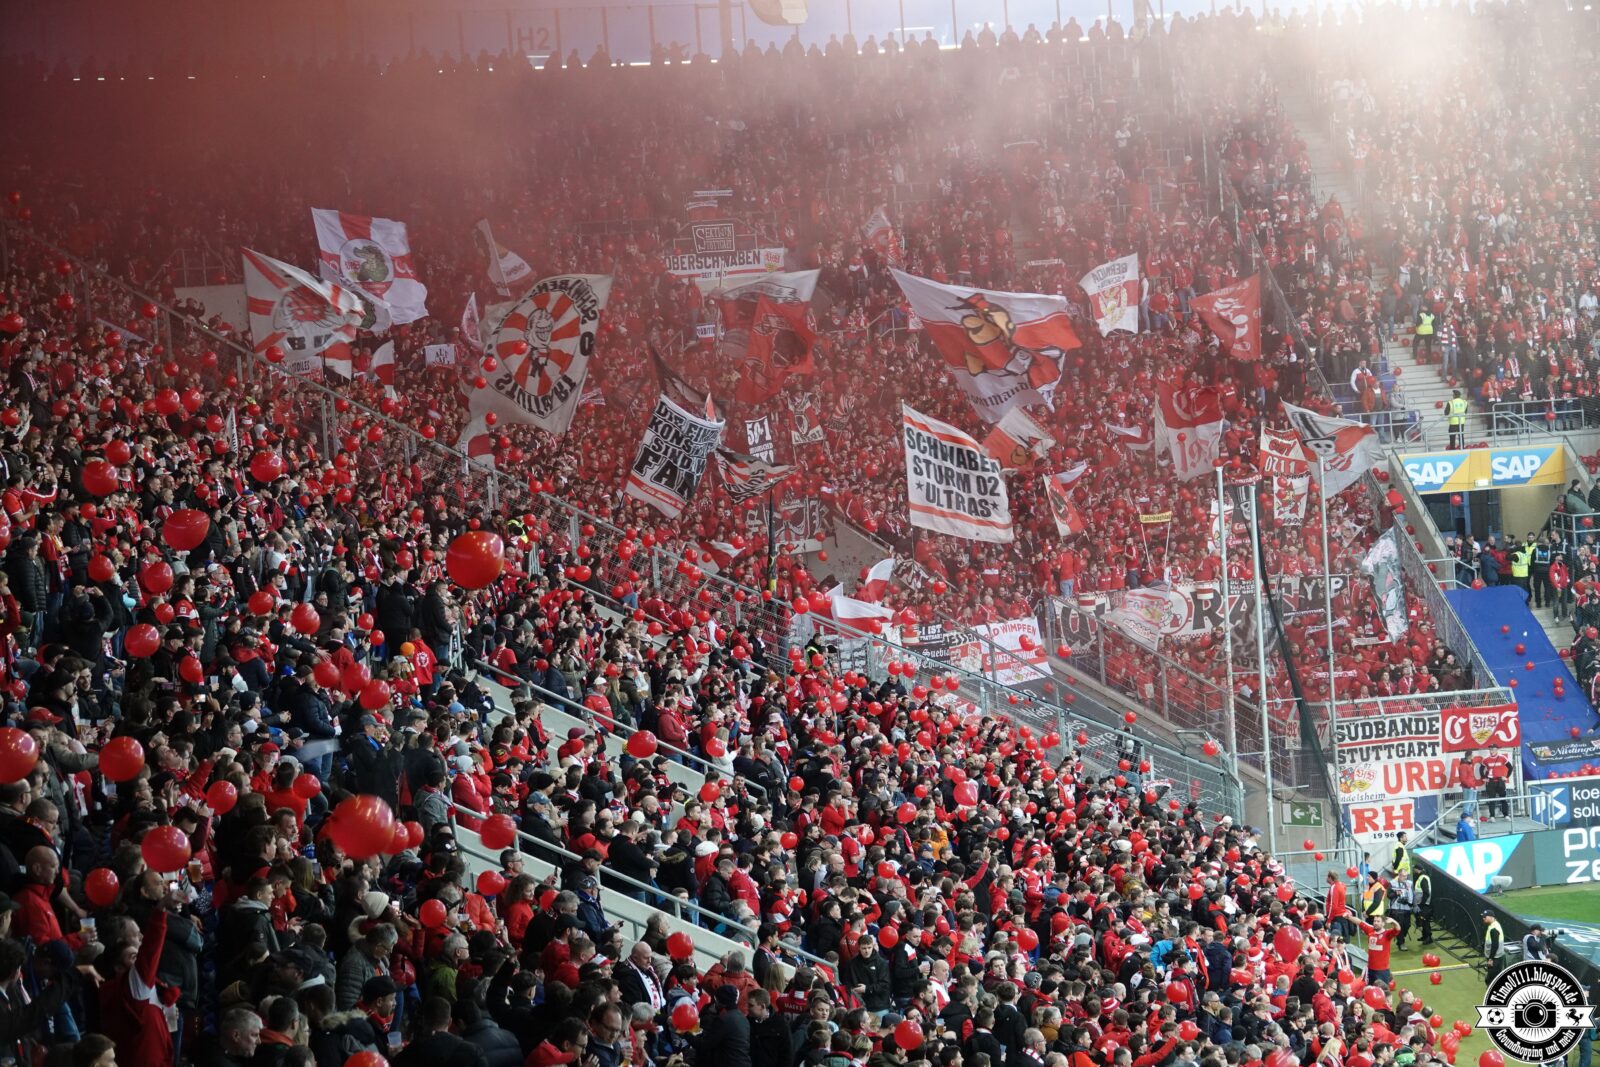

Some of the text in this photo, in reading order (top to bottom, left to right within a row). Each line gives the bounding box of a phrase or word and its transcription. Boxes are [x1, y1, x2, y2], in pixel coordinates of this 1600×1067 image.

[517, 27, 551, 50] H2
[664, 250, 760, 270] OBERSCHWABEN
[906, 427, 999, 474] SCHWABEN
[913, 454, 1000, 497] STURM 02
[1406, 461, 1454, 486] SAP
[1491, 454, 1541, 480] SAP
[925, 482, 992, 518] ULTRAS
[1000, 623, 1037, 636] WIMPFEN
[1336, 716, 1440, 743] SÜDBANDE
[1337, 741, 1440, 765] STUTTGART
[1352, 803, 1414, 834] RH
